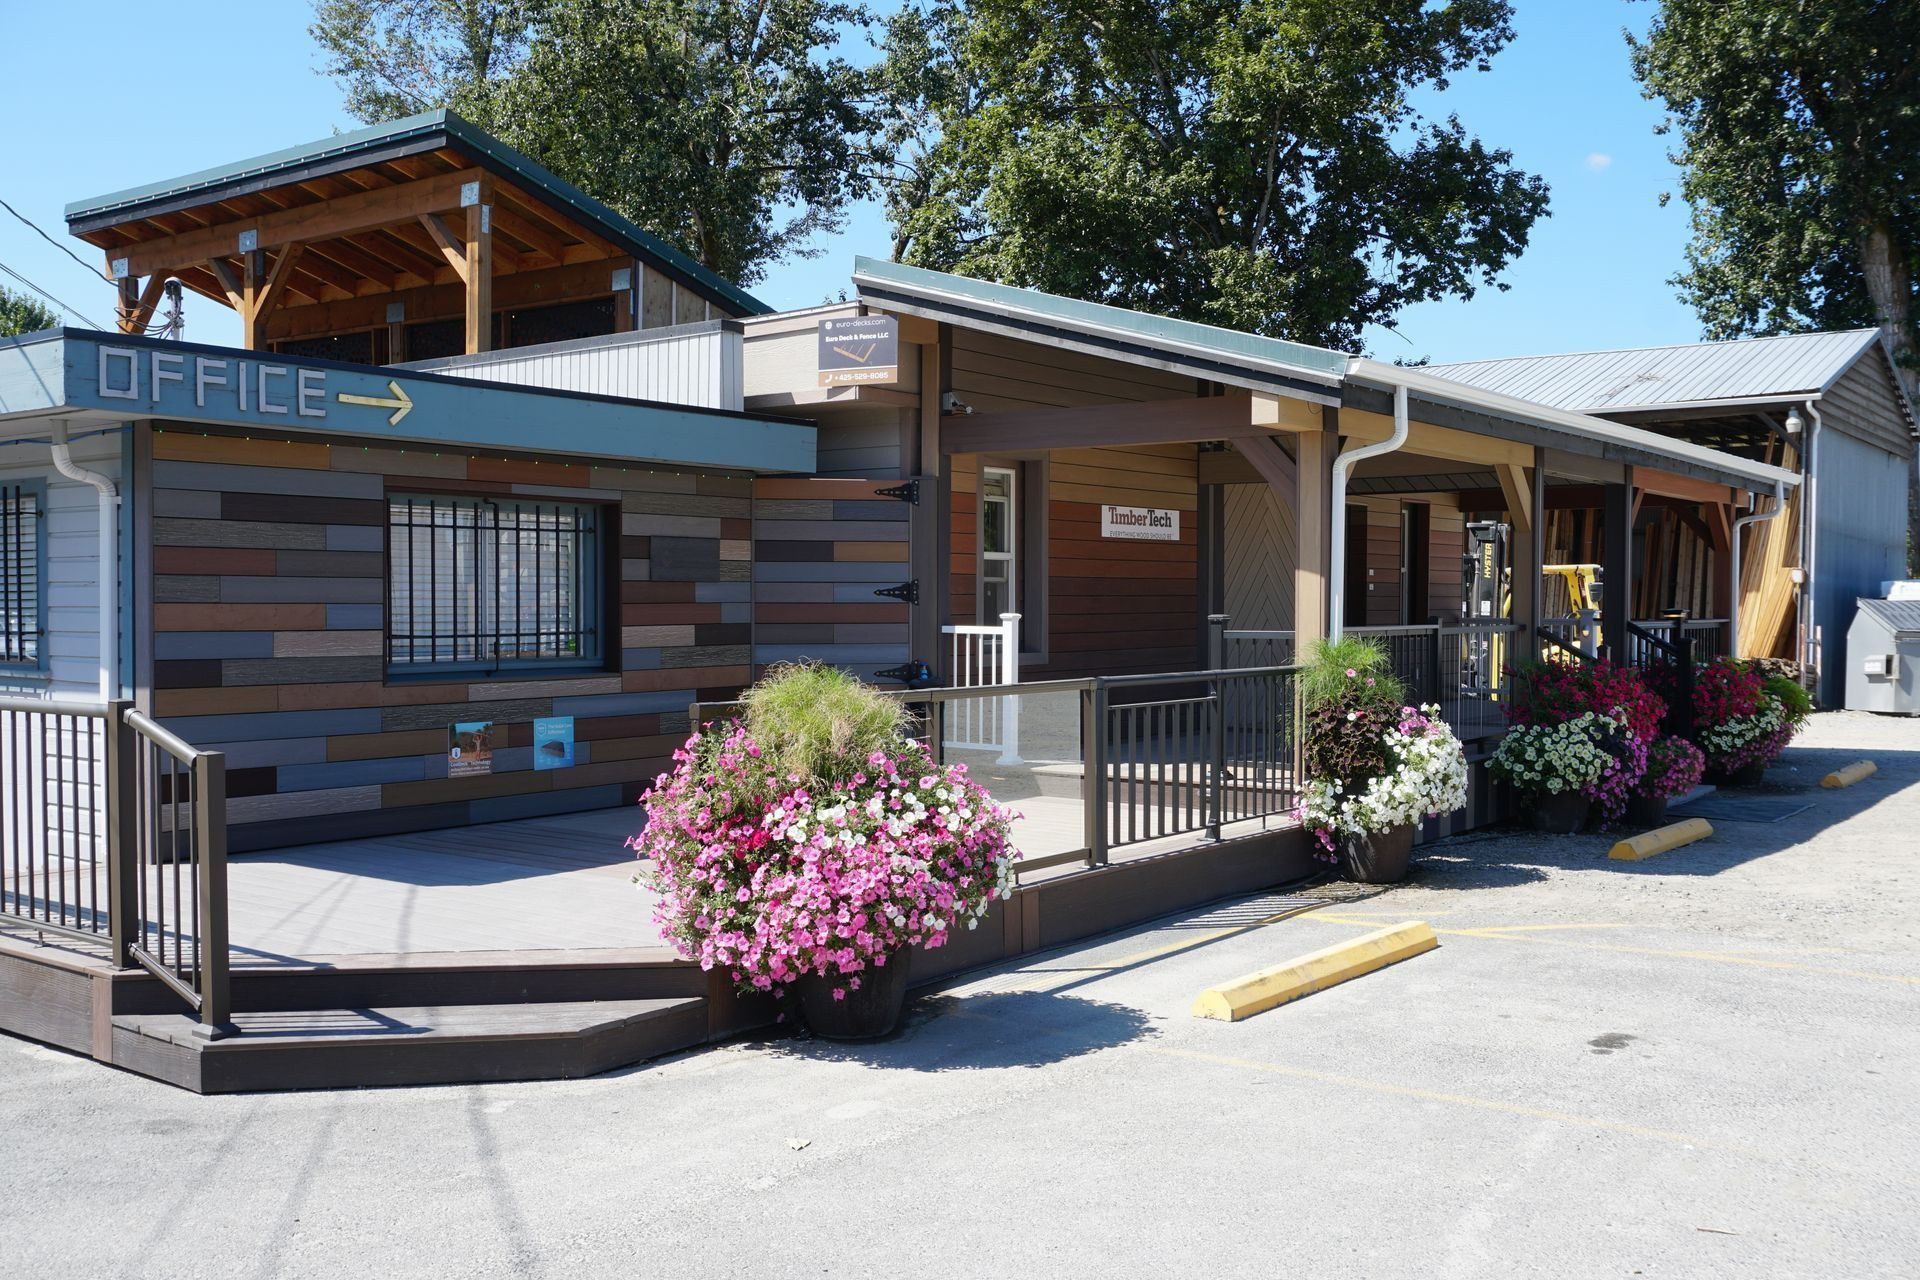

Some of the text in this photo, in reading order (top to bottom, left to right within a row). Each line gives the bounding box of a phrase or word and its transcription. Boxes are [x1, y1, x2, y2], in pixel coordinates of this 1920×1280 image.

[836, 319, 886, 328] euro-decks.com
[99, 344, 326, 417] OFFICE
[1108, 506, 1172, 528] TimberTech
[1484, 543, 1493, 579] HYSTER
